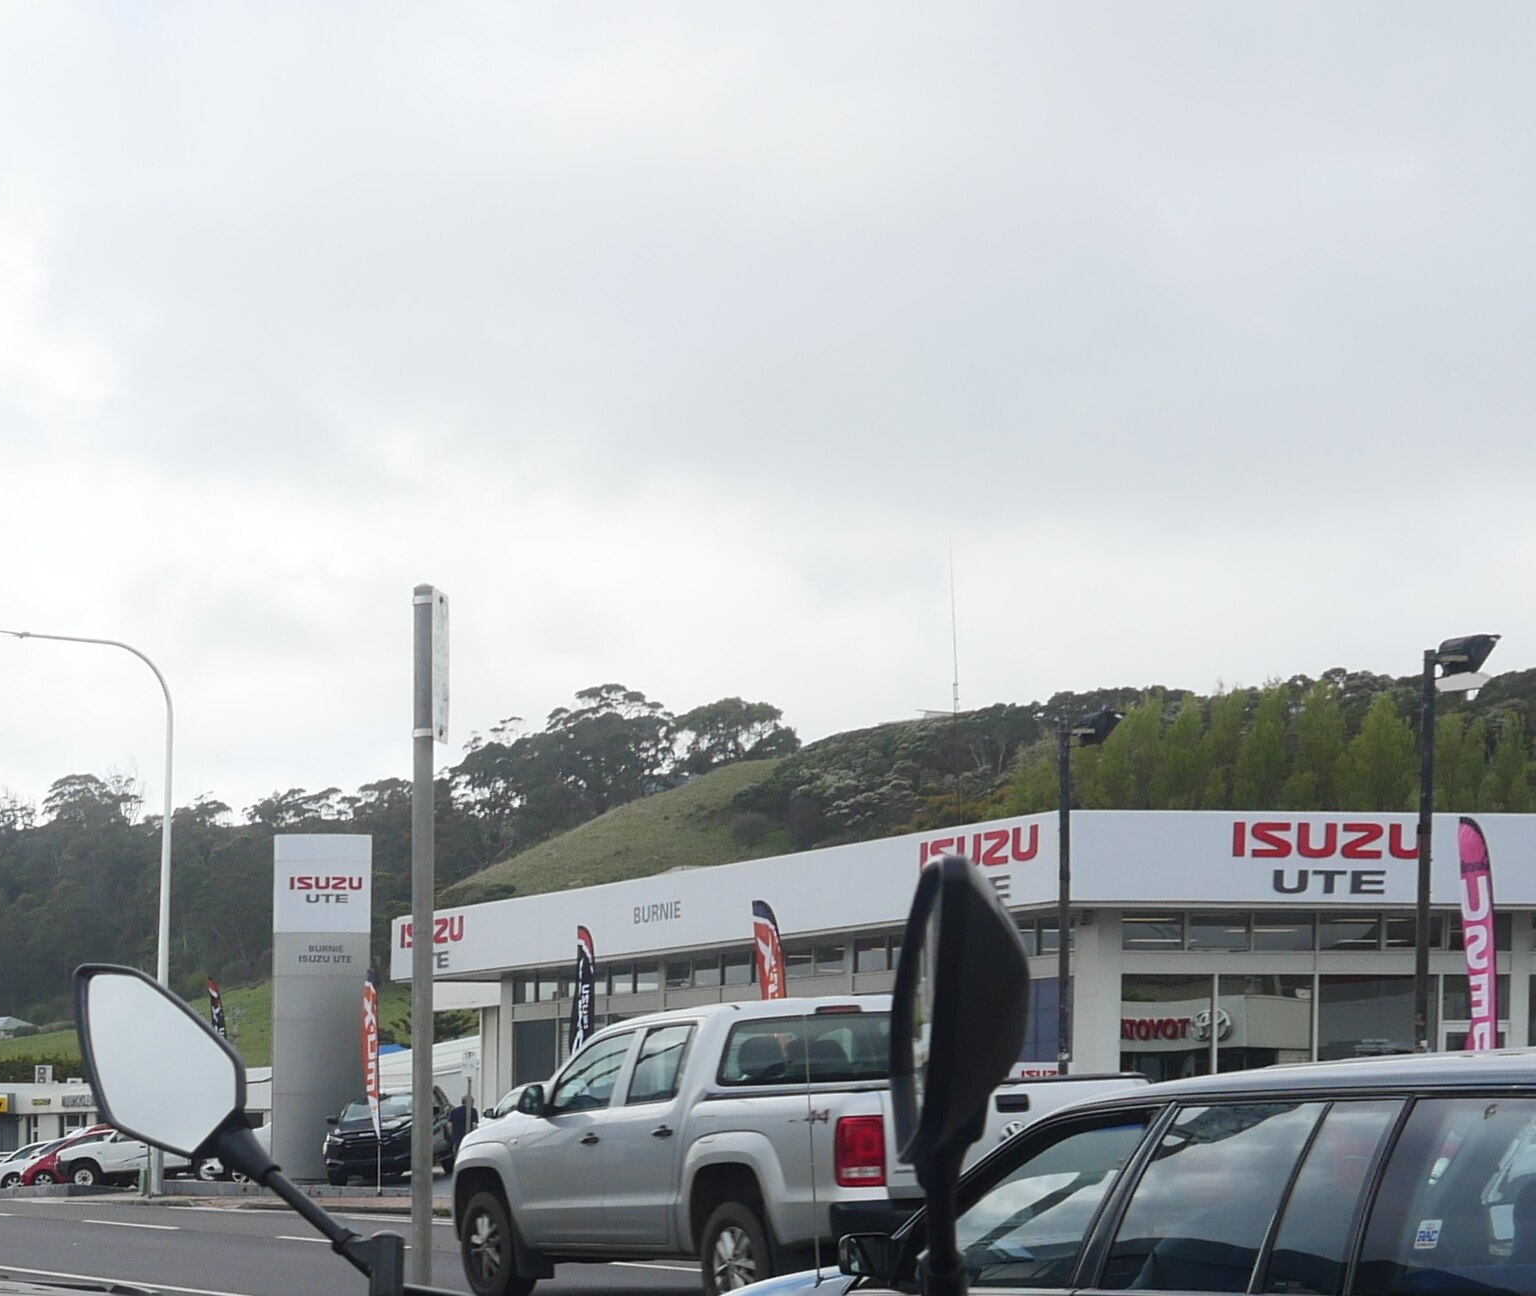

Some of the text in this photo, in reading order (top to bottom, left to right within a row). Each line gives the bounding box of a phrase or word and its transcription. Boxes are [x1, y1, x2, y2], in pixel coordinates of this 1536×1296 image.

[1232, 821, 1420, 860] ISUZU
[289, 876, 363, 890] ISUZU
[1272, 869, 1386, 894] UTE
[305, 894, 349, 903] UTE
[633, 900, 681, 925] BURNIE
[400, 915, 464, 949] IZU
[308, 945, 344, 953] BURNIE
[298, 955, 352, 963] ISUZU UTE
